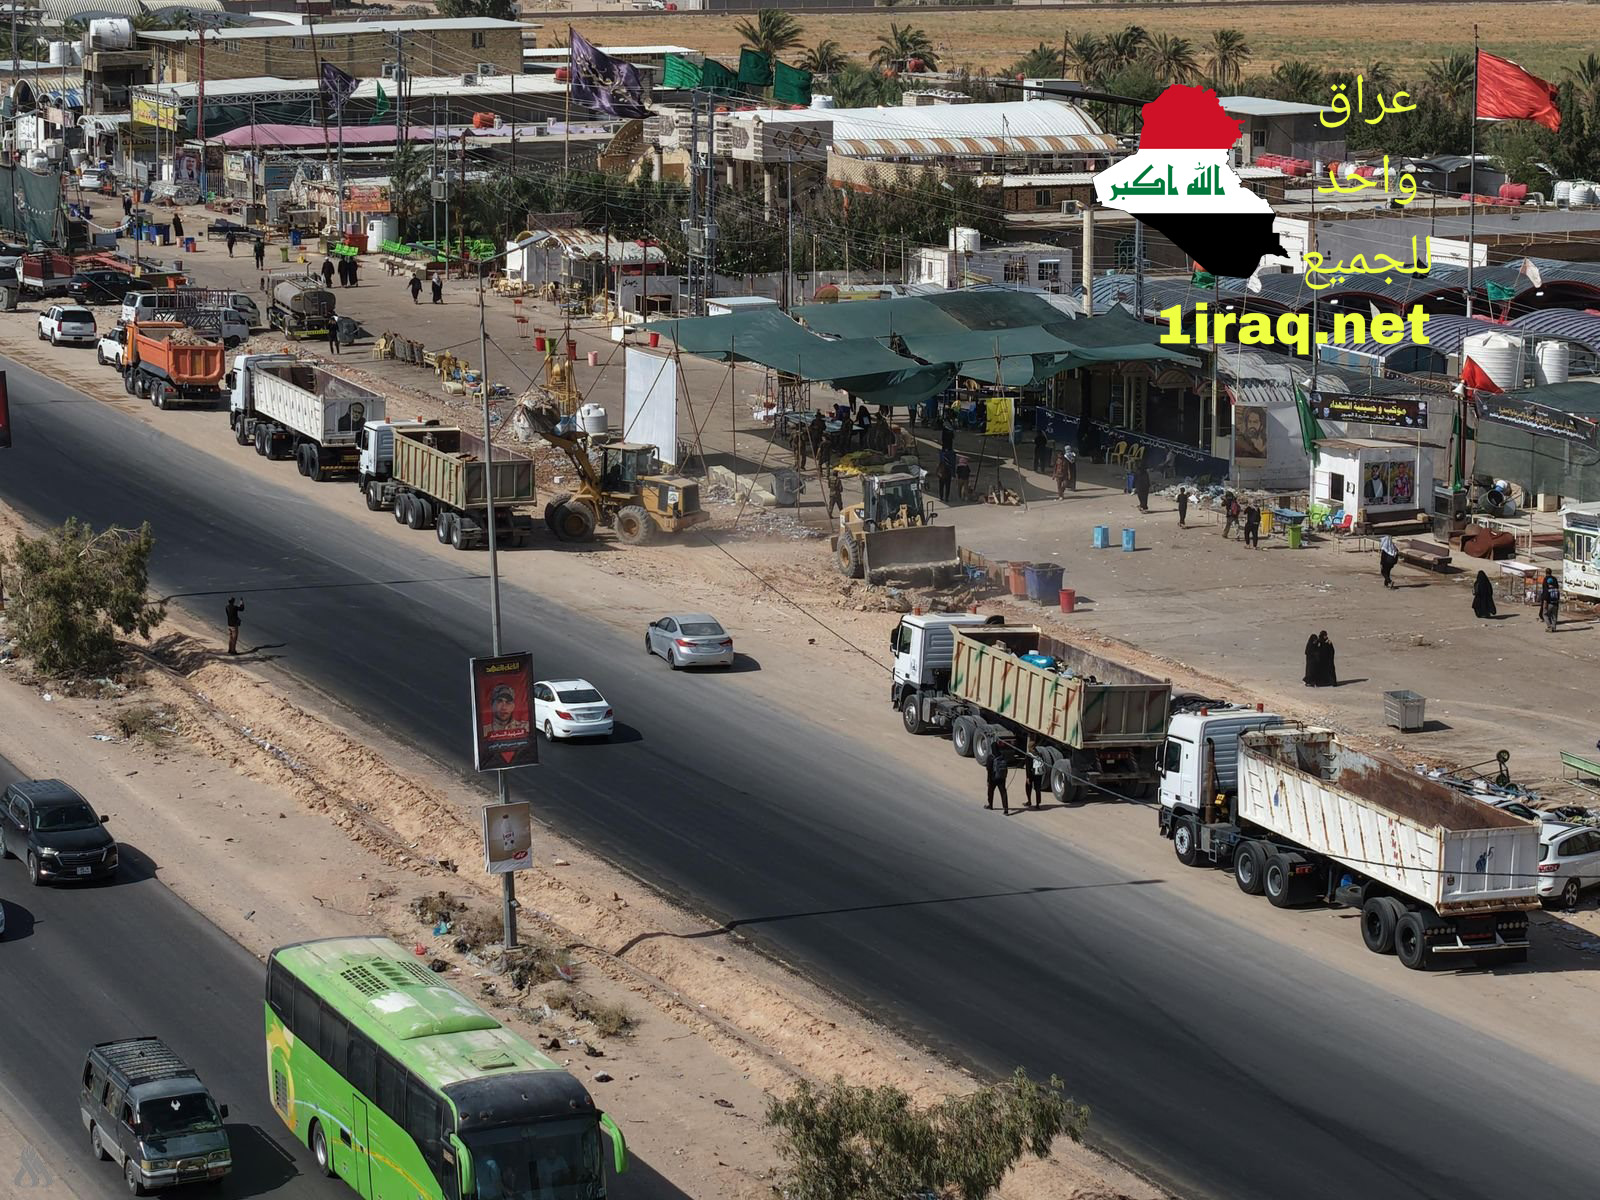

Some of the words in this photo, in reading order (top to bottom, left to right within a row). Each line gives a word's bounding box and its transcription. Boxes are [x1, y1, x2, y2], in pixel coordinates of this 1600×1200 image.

[1329, 399, 1353, 410] الشهداء
[1353, 401, 1377, 412] حسينية
[1378, 405, 1383, 415] و
[1384, 406, 1407, 416] موكب
[1388, 817, 1401, 881] MAMMUT
